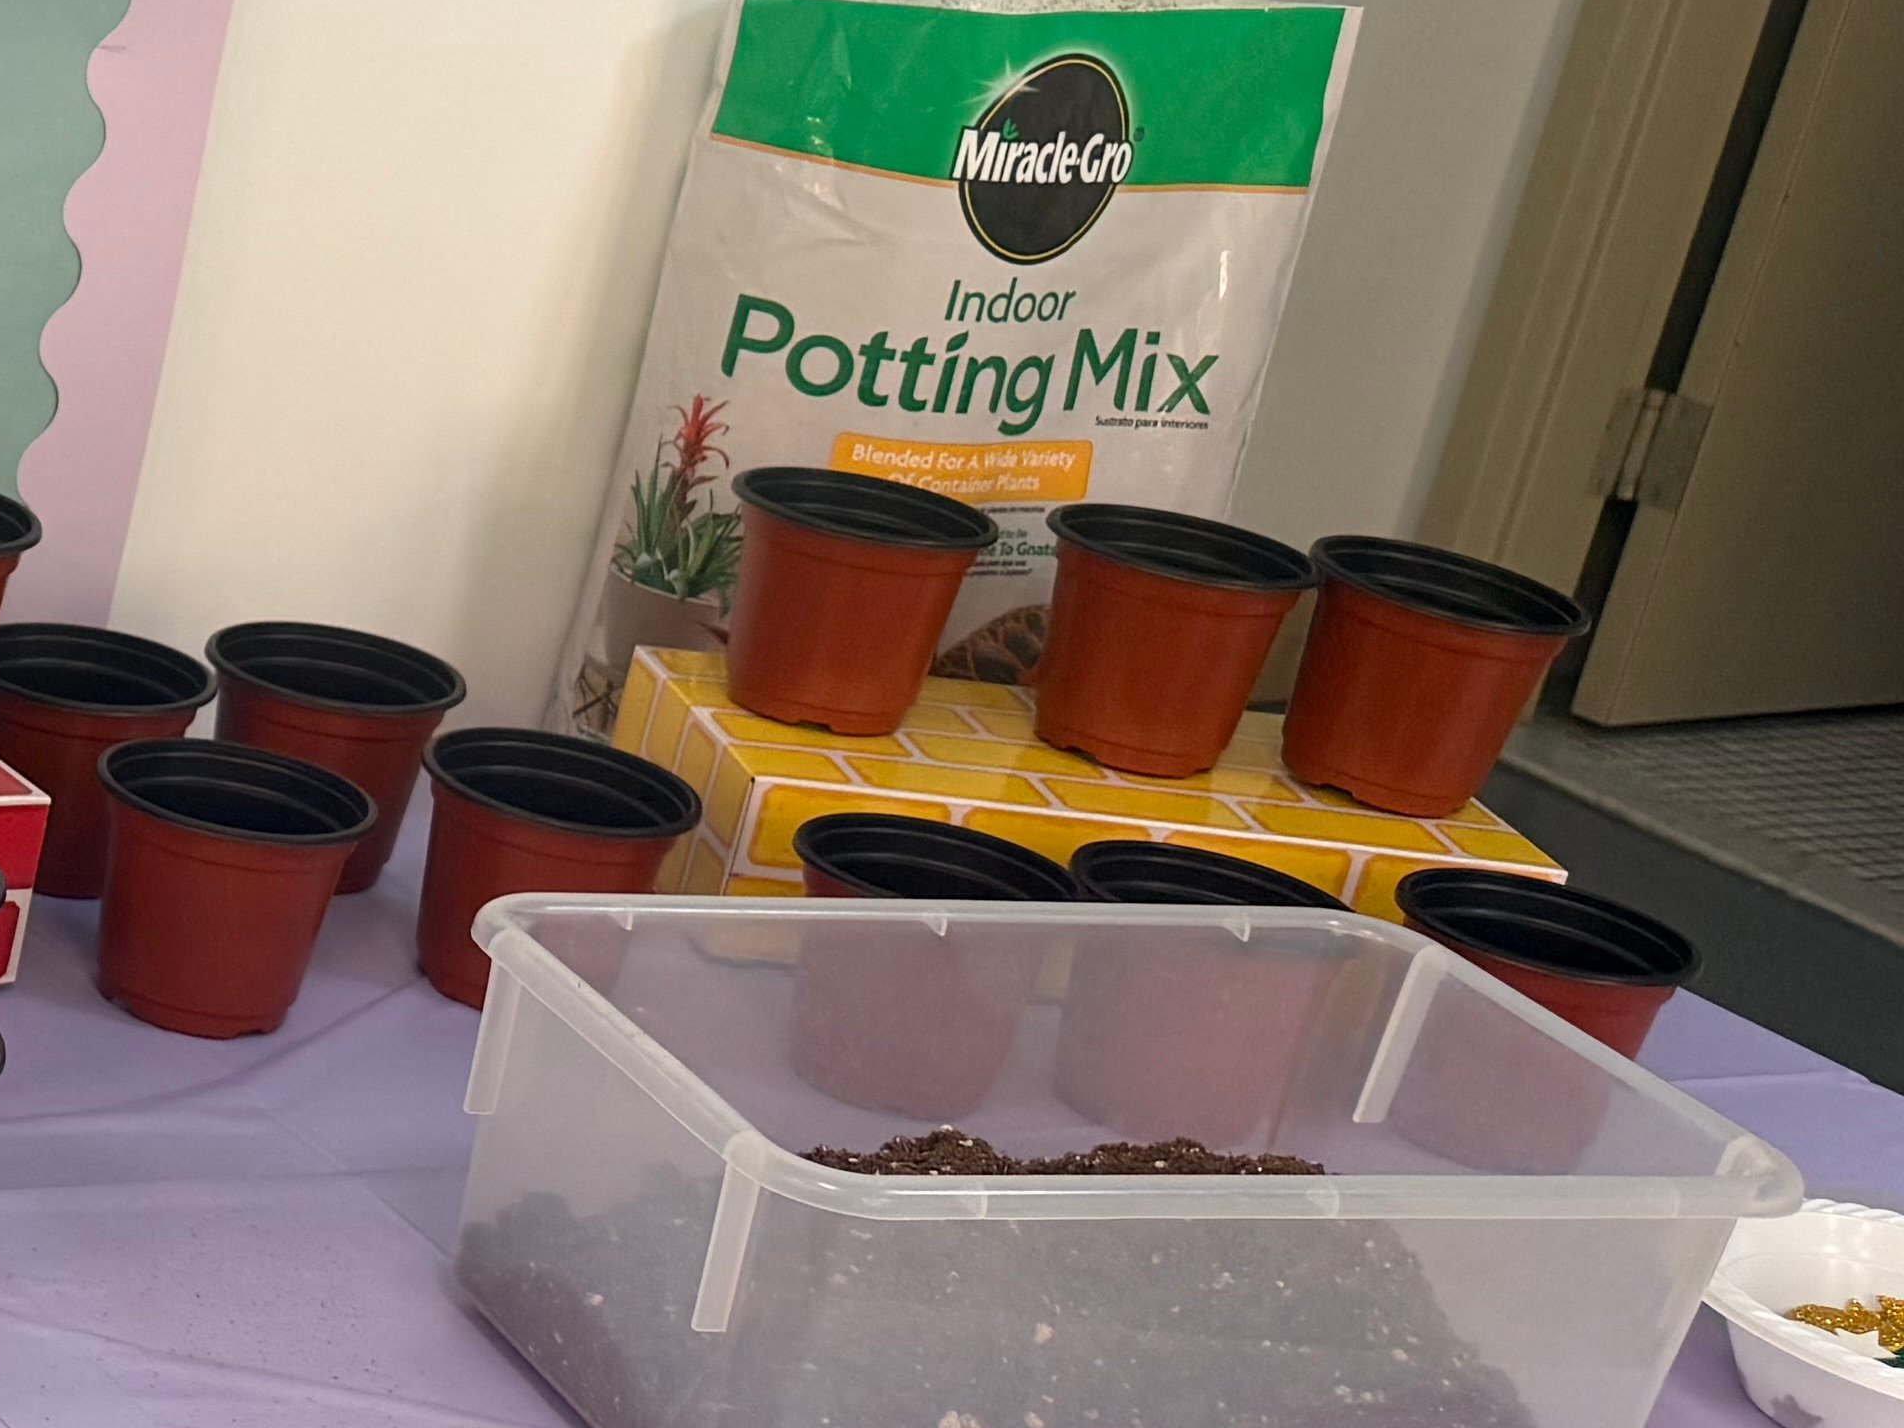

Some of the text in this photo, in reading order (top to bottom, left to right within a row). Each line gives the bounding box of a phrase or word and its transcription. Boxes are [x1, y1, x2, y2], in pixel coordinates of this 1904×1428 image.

[943, 276, 1077, 325] Indoor
[720, 292, 1221, 437] Potting Mix
[851, 443, 1077, 471] Blended For A Wide Variety
[917, 474, 994, 495] Container
[996, 475, 1041, 492] Plants
